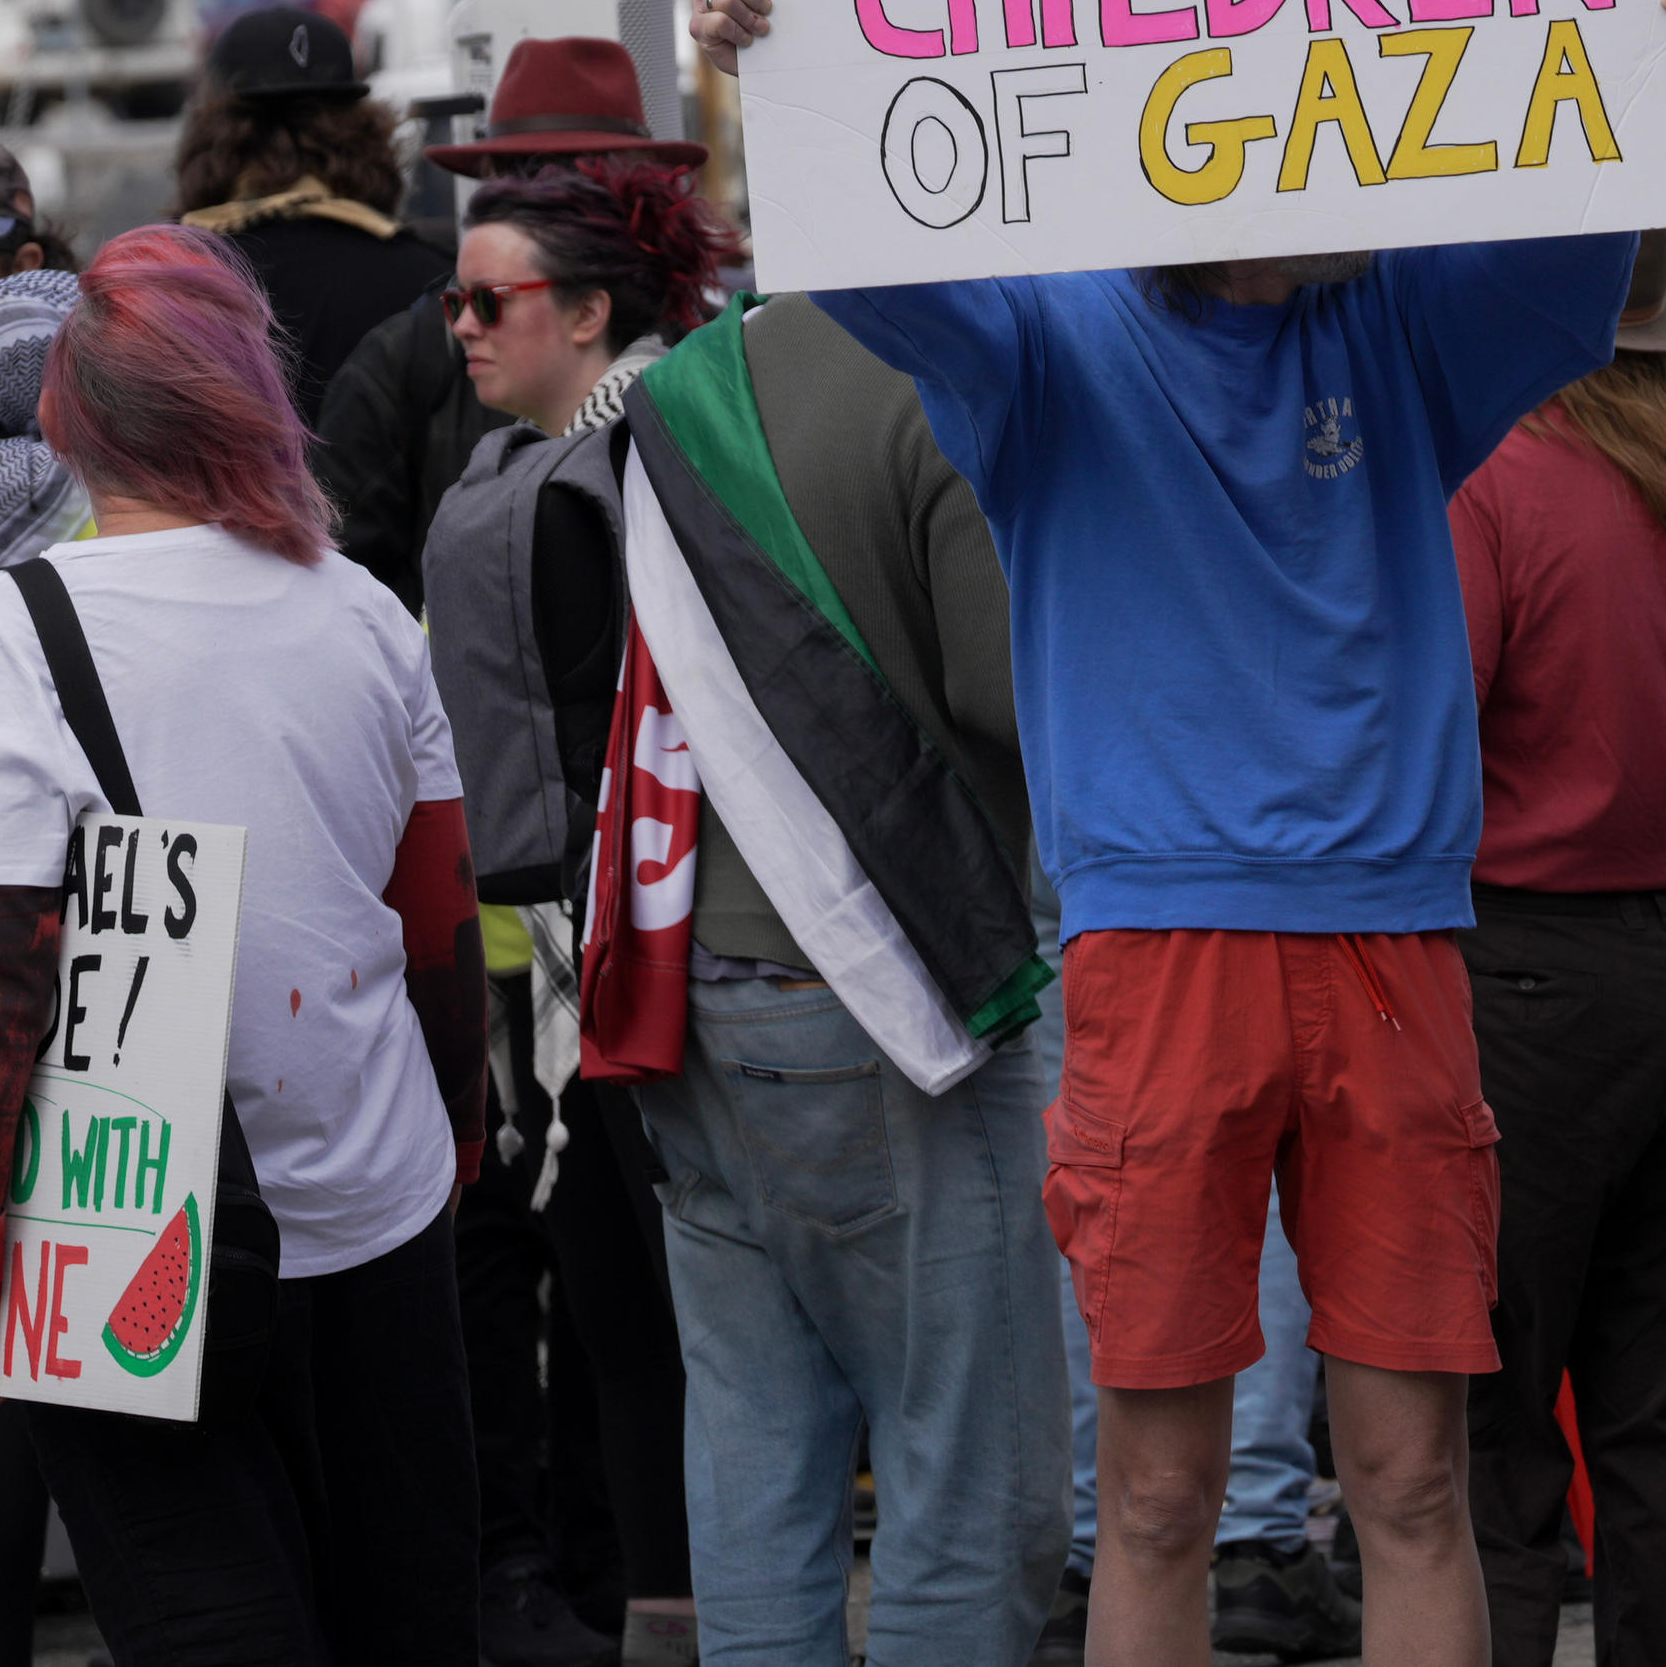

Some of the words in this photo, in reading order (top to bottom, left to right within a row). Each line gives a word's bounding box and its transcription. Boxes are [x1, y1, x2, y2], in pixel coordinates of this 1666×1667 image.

[880, 62, 1088, 230] OF
[1139, 18, 1624, 206] GAZA
[1303, 397, 1352, 429] RTHA
[60, 824, 197, 940] AEL'S
[61, 1109, 171, 1214] WITH
